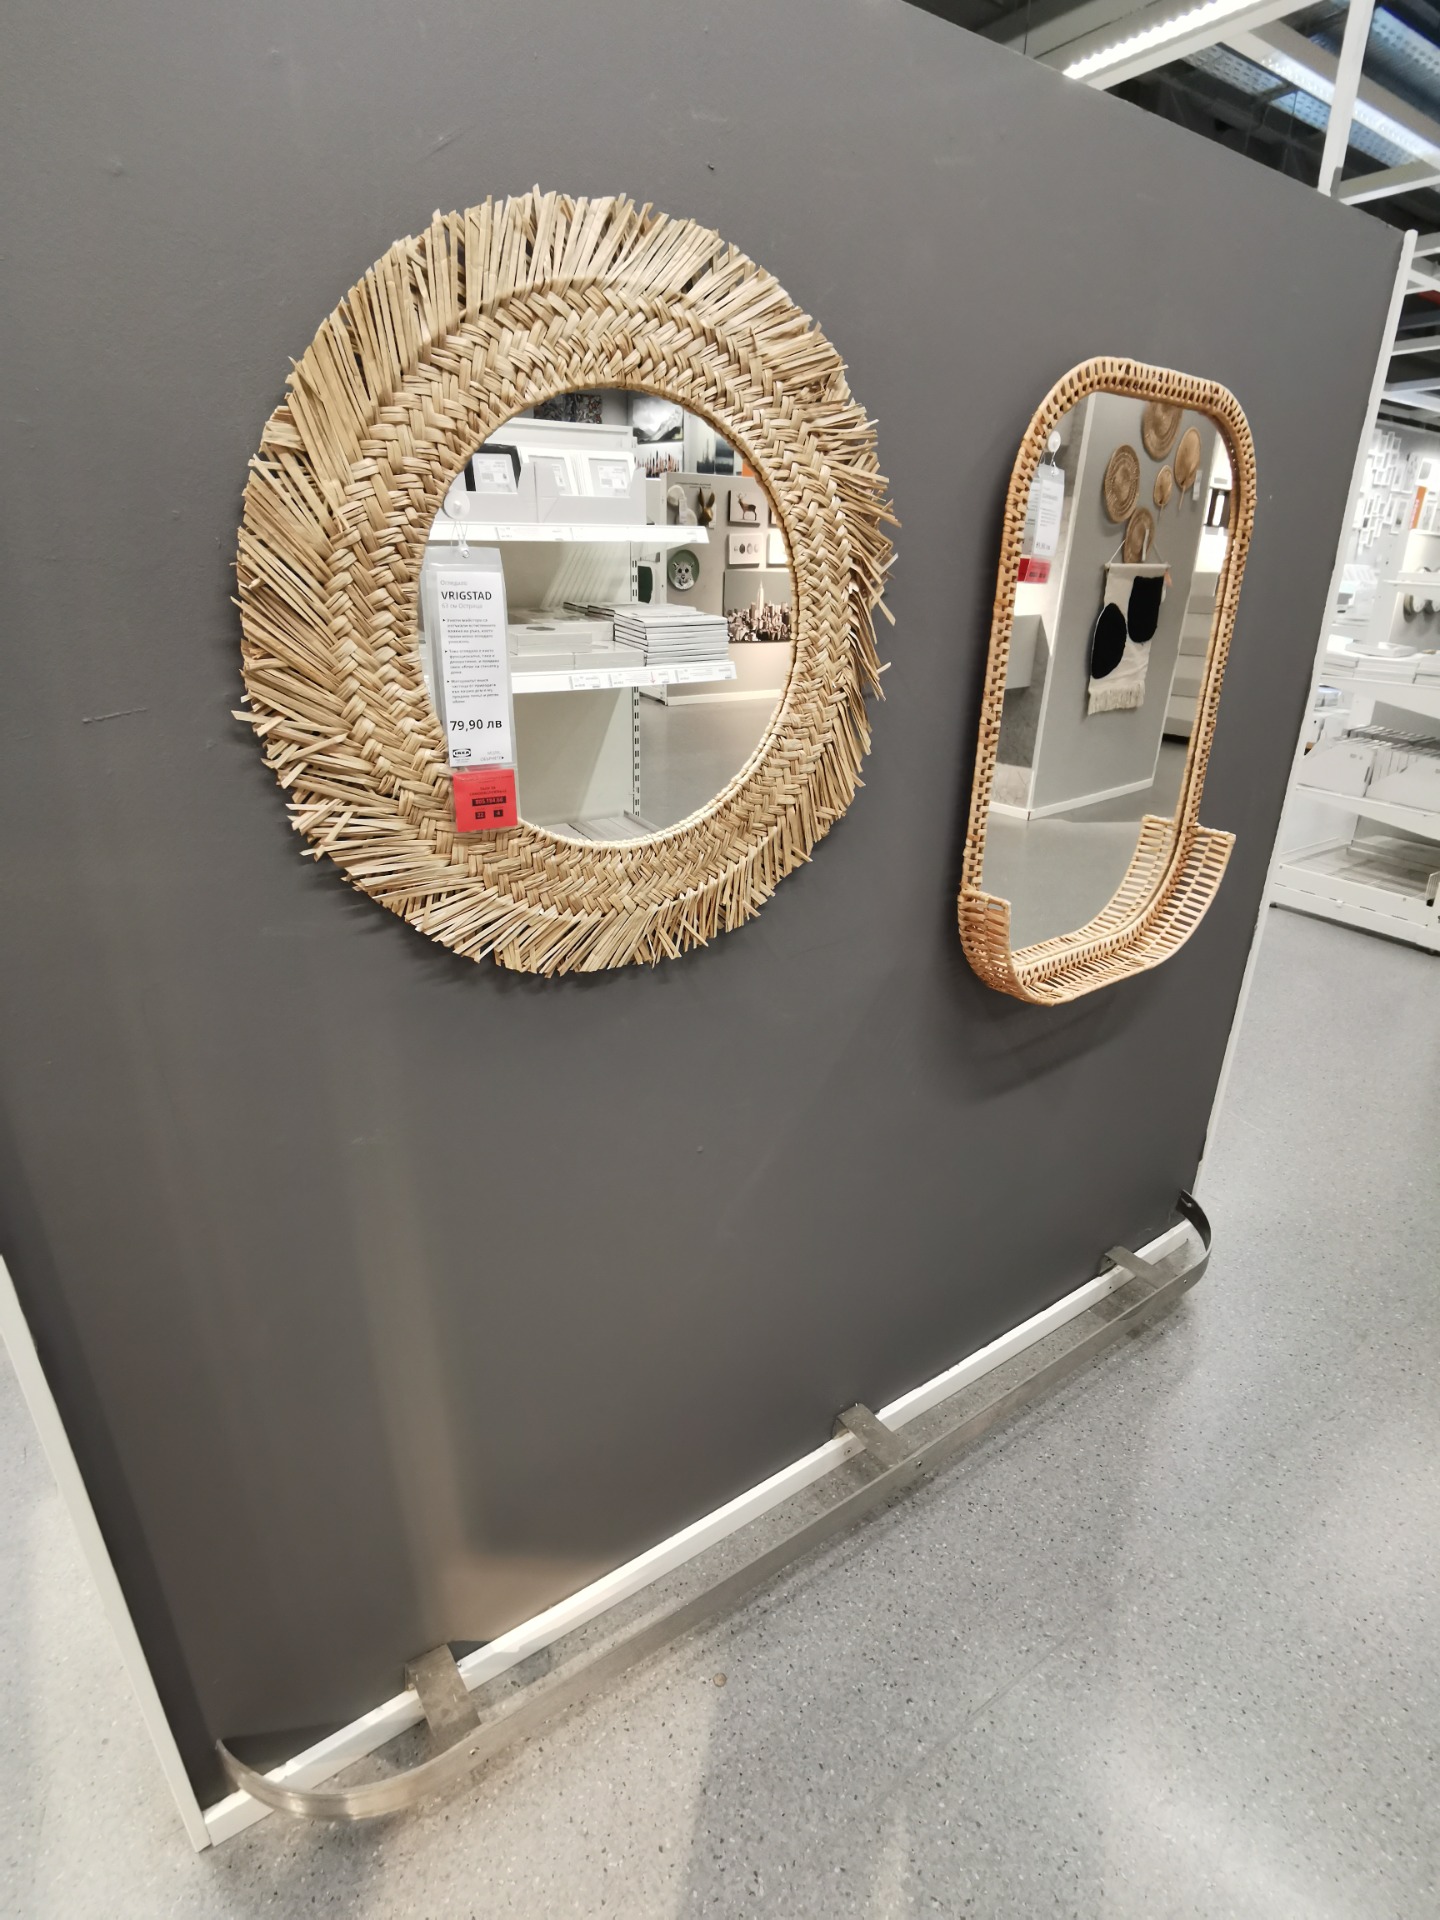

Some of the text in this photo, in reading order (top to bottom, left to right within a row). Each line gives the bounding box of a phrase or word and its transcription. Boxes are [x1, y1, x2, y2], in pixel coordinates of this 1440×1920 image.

[441, 591, 492, 601] VRIGSTAD
[450, 719, 502, 732] 79,90 лв
